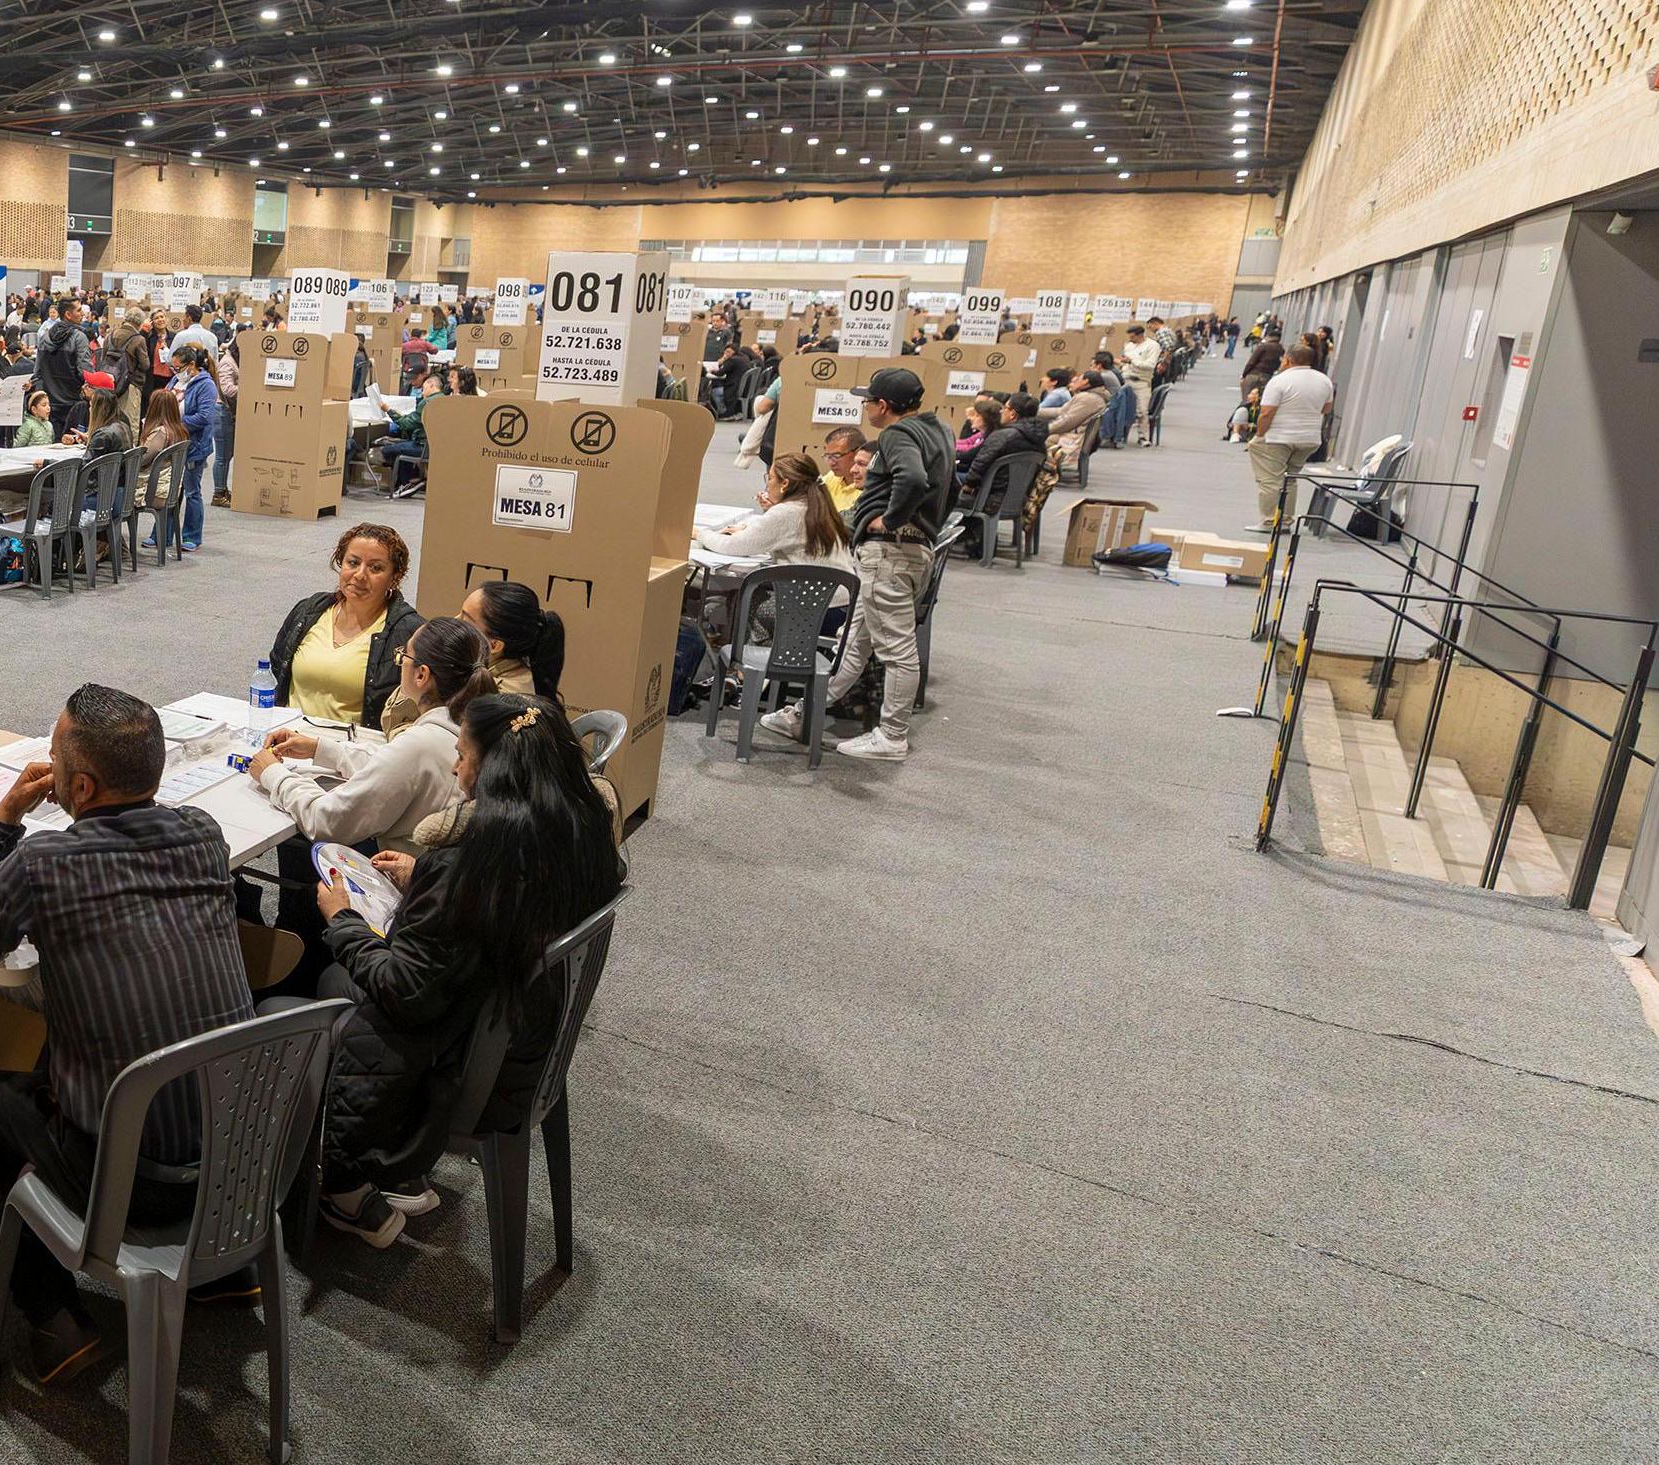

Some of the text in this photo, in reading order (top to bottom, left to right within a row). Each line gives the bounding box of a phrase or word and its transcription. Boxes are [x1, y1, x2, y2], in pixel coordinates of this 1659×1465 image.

[152, 279, 164, 288] 105
[173, 277, 190, 288] 097
[294, 276, 322, 294] 089
[325, 277, 347, 297] 089
[372, 283, 387, 293] 106
[498, 284, 521, 297] 098
[551, 271, 623, 313] 081
[636, 272, 665, 313] 081
[672, 288, 691, 299] 107
[769, 292, 786, 301] 116
[849, 289, 894, 312] 090
[967, 296, 1001, 312] 099
[1039, 296, 1062, 308] 108
[546, 335, 622, 350] 52.721.638
[552, 357, 573, 365] HASTA
[268, 372, 283, 380] MESA
[543, 366, 618, 382] 52.723.489
[818, 407, 858, 417] MESA 90
[481, 447, 610, 469] Prohibido el uso de celular
[500, 497, 565, 519] MESA 81
